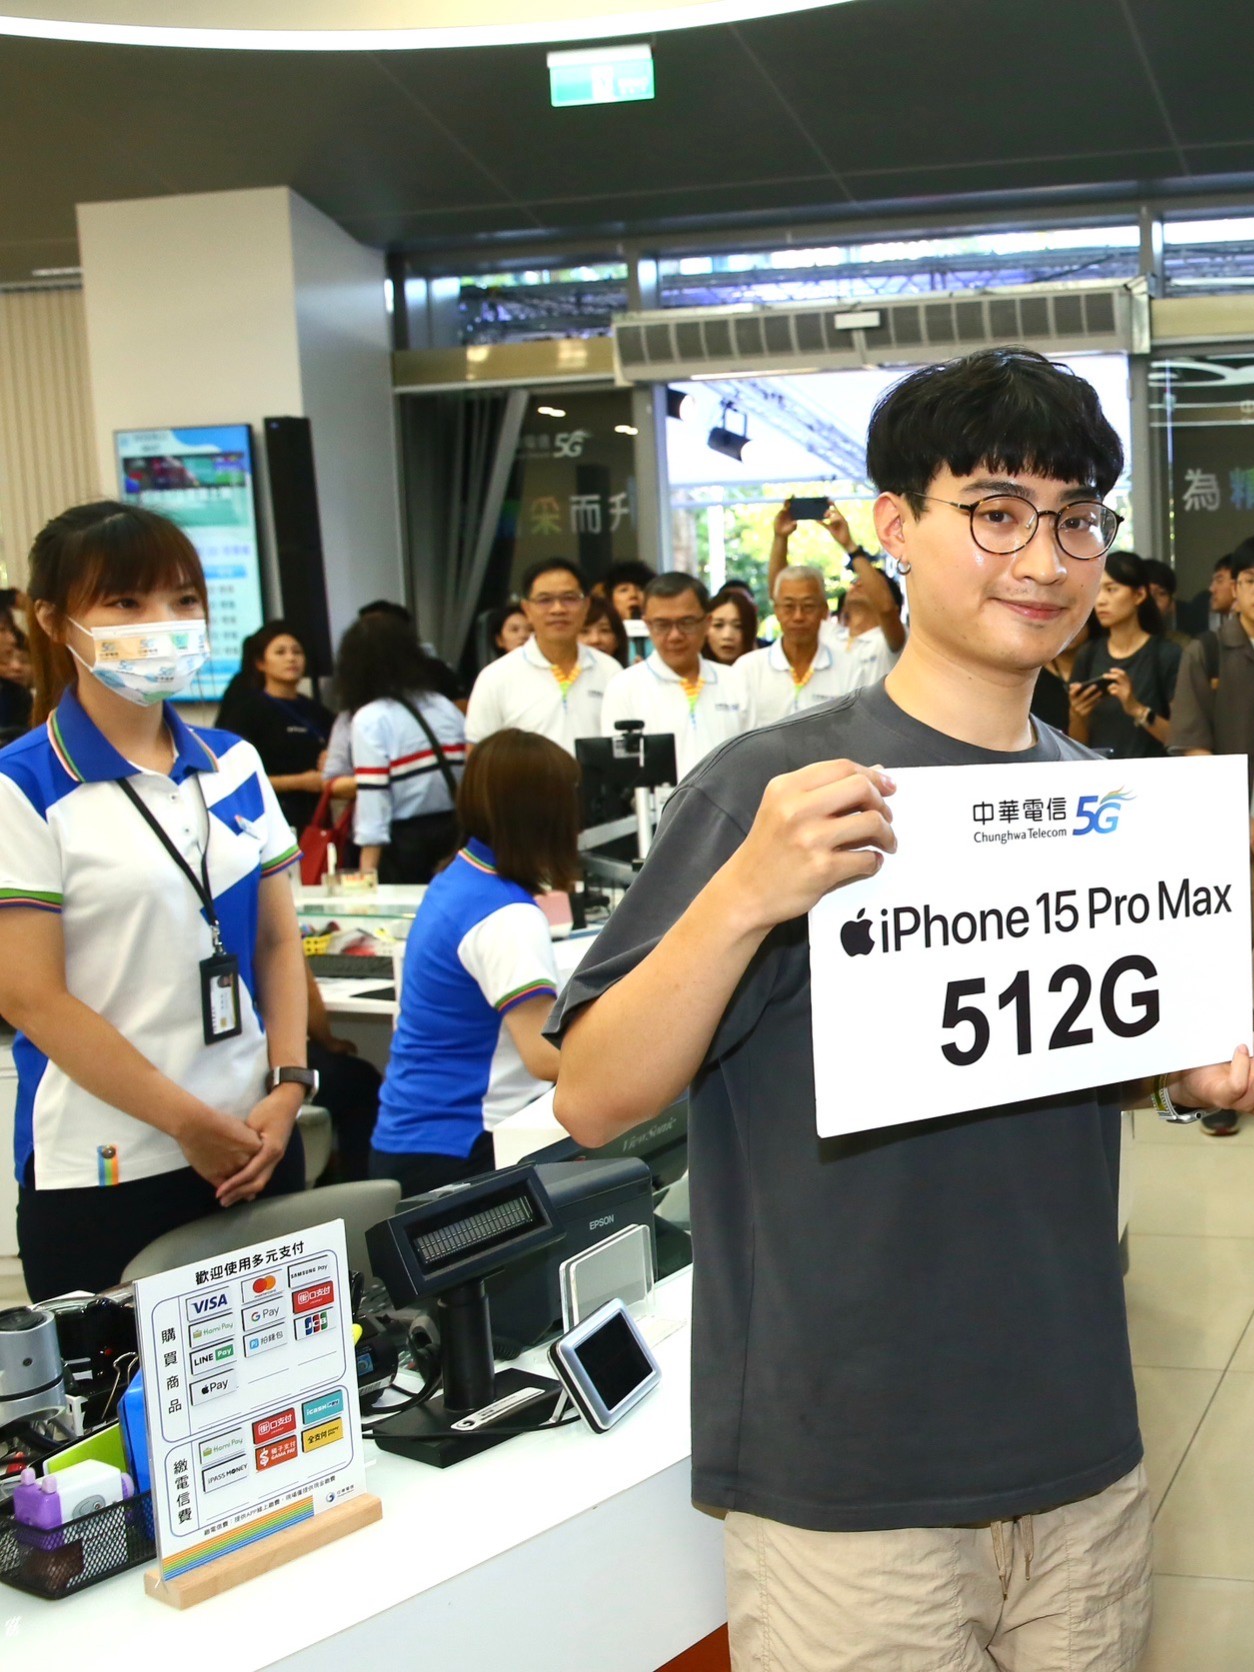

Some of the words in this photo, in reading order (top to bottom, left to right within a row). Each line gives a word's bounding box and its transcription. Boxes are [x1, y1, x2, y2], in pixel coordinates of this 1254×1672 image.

[973, 797, 1067, 825] 中華電信
[1072, 795, 1123, 836] 5G
[973, 830, 1027, 844] Chunghwa
[1027, 828, 1067, 839] Telecom
[881, 904, 1030, 954] iPhone
[1035, 889, 1079, 934] 15
[1089, 887, 1150, 929] Pro
[1158, 878, 1232, 921] Max
[940, 954, 1160, 1067] 512G
[589, 1214, 615, 1230] EPSON
[195, 1240, 305, 1286] 歡迎使用多元支付
[290, 1267, 316, 1279] SAMSUNG
[191, 1293, 228, 1314] VISA
[262, 1306, 280, 1319] Pay
[203, 1325, 221, 1336] Hami
[221, 1322, 233, 1333] Pay
[304, 1311, 329, 1336] JCB
[161, 1327, 183, 1414] 購買商品
[194, 1353, 214, 1367] LINE
[210, 1379, 229, 1393] Pay
[258, 1414, 293, 1435] 街口支付
[213, 1442, 231, 1453] Hami
[231, 1437, 243, 1448] Pay
[173, 1457, 193, 1525] 繳電信費
